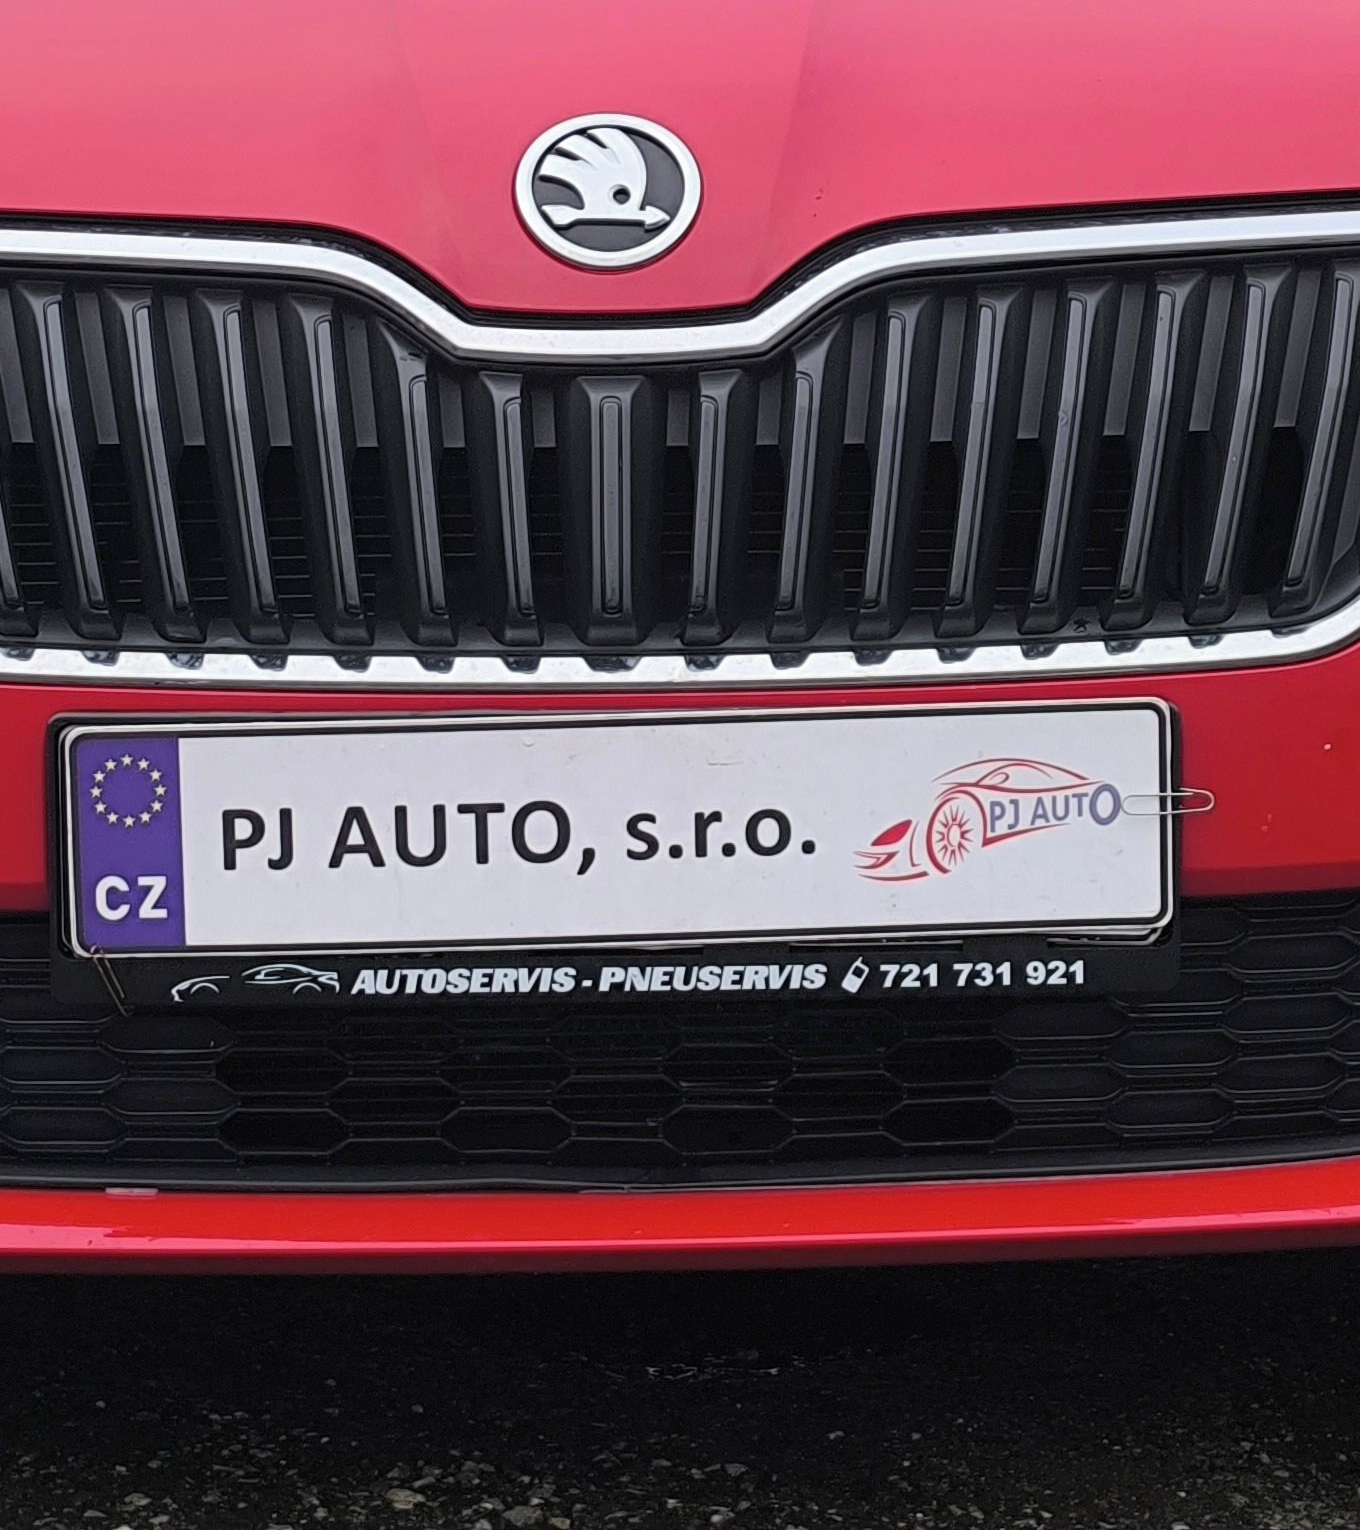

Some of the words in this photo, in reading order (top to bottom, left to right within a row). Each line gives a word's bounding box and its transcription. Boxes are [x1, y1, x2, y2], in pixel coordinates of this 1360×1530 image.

[989, 798, 1020, 833] PJ
[1030, 783, 1122, 826] AUTO
[222, 807, 294, 871] PJ
[328, 800, 596, 876] AUTO,
[626, 808, 816, 861] s.r.o.
[95, 875, 168, 921] CZ
[351, 967, 577, 996] AUTOSERVIS
[598, 964, 828, 993] PNEUSERVIS
[880, 962, 938, 988] 721
[953, 961, 1011, 987] 731
[1026, 959, 1084, 985] 921
